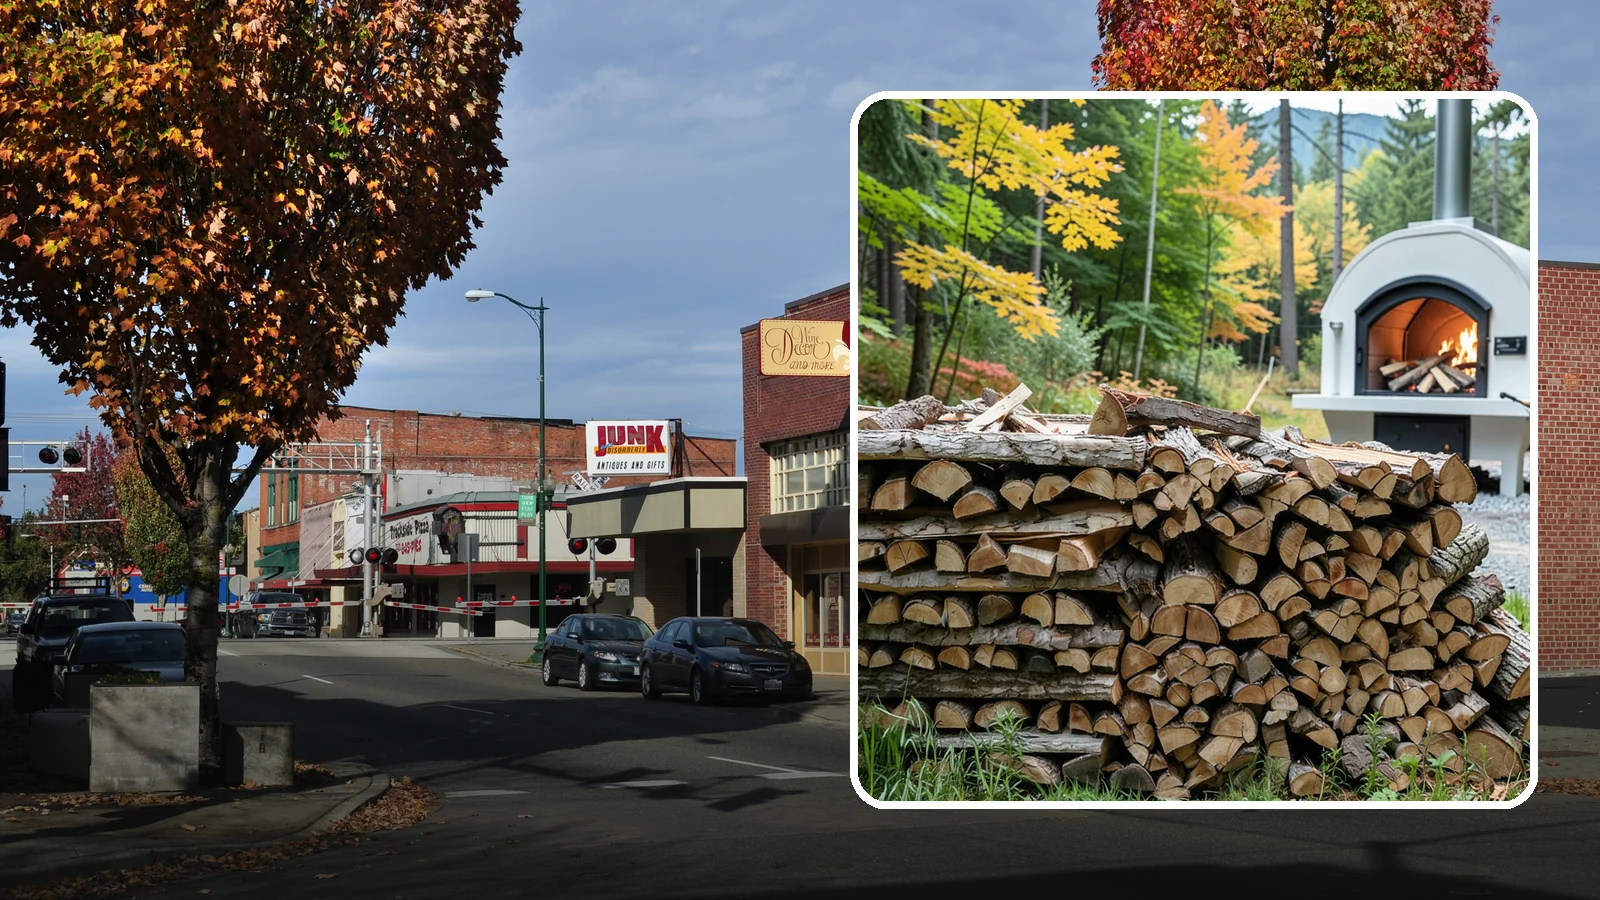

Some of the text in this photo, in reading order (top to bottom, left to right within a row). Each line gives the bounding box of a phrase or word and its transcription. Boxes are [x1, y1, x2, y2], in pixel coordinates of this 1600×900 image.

[595, 425, 664, 457] JUNK
[607, 446, 646, 454] DISORDERLY
[597, 460, 665, 470] ANTIQUES AND GIFTS
[390, 519, 429, 539] Trackside Pizza
